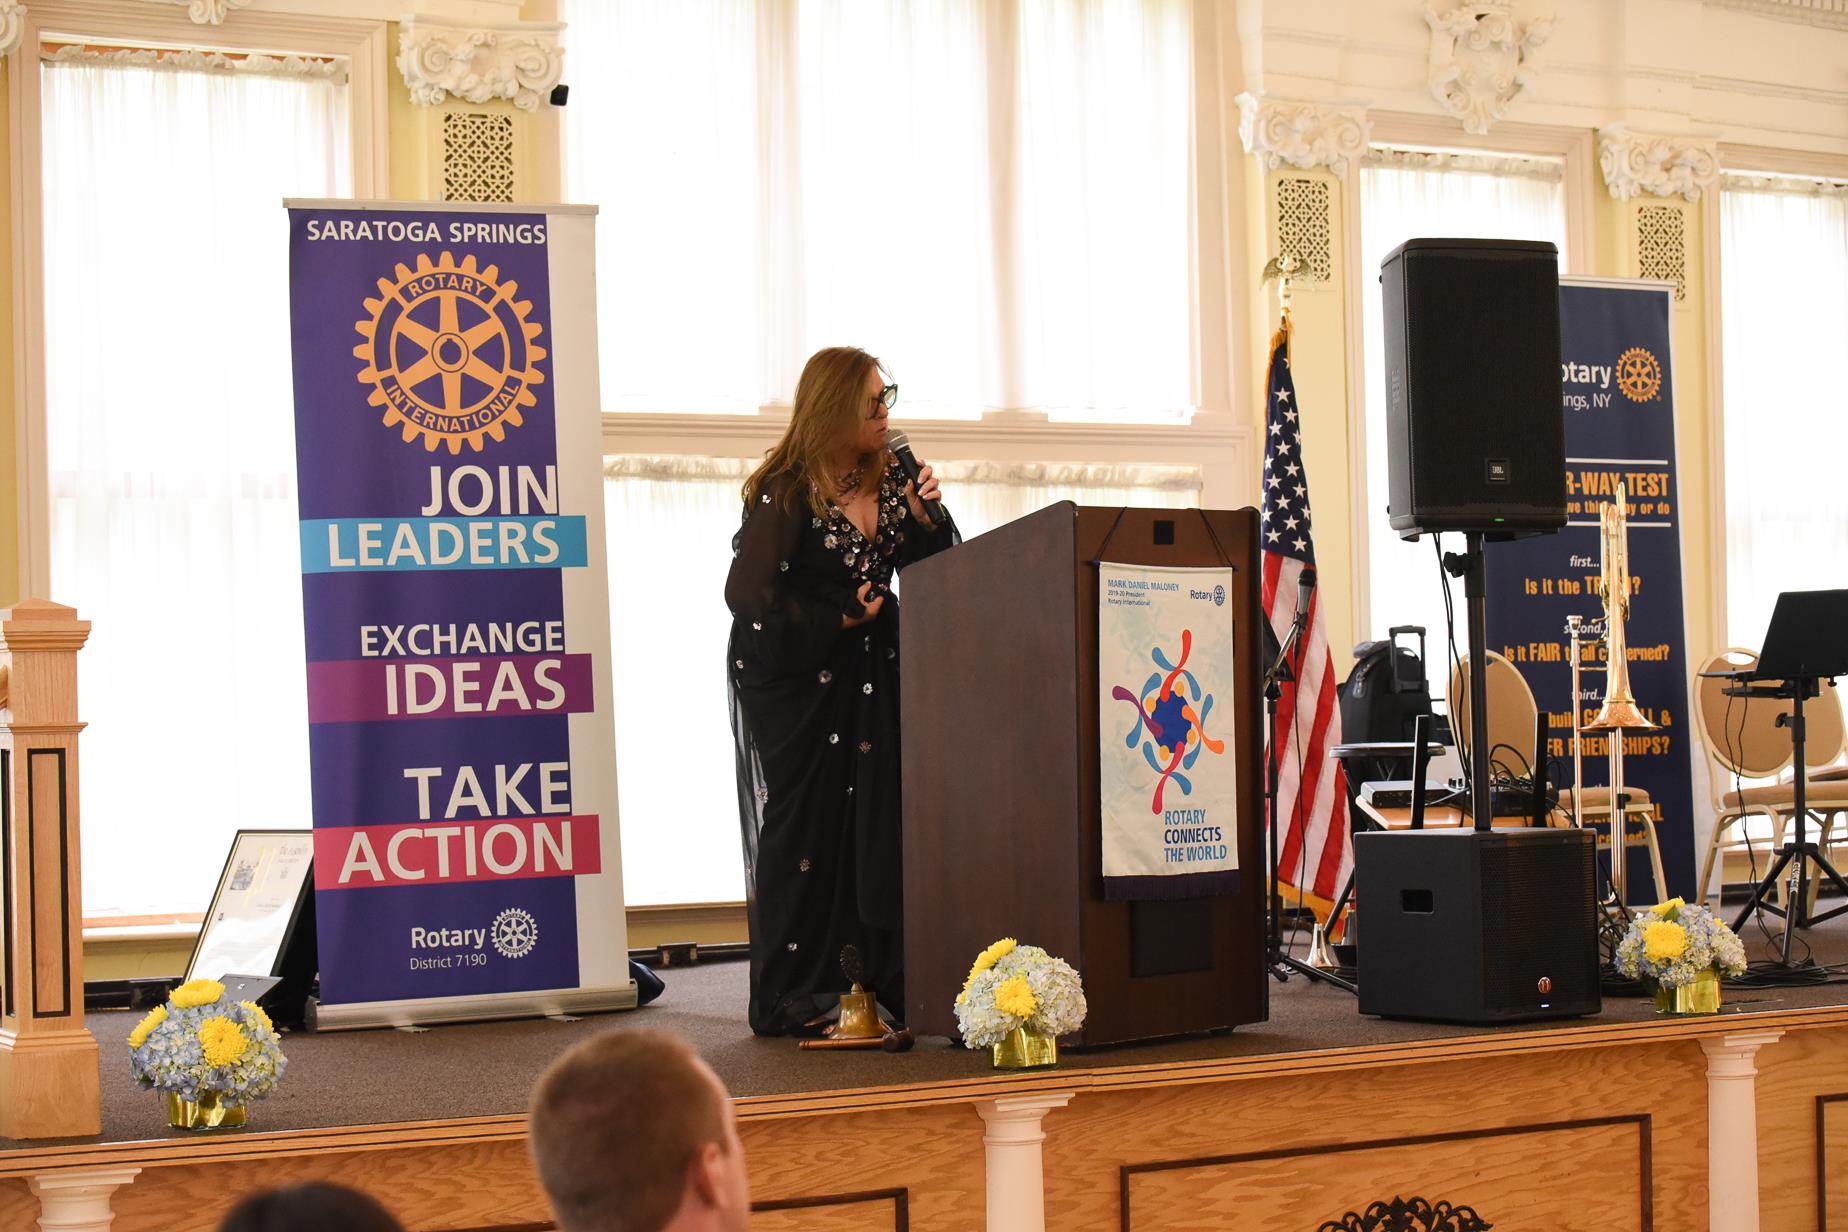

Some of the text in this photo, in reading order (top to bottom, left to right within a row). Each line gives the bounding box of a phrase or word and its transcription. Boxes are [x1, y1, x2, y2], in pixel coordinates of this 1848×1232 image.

[307, 220, 547, 245] SARATOGA SPRINGS
[407, 273, 488, 298] ROTARY
[1562, 361, 1612, 389] otary
[386, 383, 521, 434] INTERNATIONAL
[1563, 392, 1612, 411] ings, NY
[421, 464, 558, 517] JOIN
[1566, 472, 1669, 497] R-WAY TEST
[1640, 503, 1654, 515] or
[1657, 501, 1670, 515] do
[328, 520, 561, 567] LEADERS
[1570, 555, 1600, 568] first...
[1107, 579, 1180, 592] MARK DANIEL MALONEY
[1190, 589, 1213, 602] Rotary
[1525, 578, 1538, 595] Is
[1543, 577, 1553, 595] it
[1558, 577, 1581, 595] the
[360, 620, 564, 657] EXCHANGE
[1504, 645, 1515, 662] Is
[1517, 645, 1526, 662] it
[1529, 643, 1561, 662] FAIR
[1581, 645, 1595, 661] all
[1598, 644, 1670, 662] cerned?
[385, 659, 567, 716] IDEAS
[1548, 711, 1575, 728] buil
[1661, 709, 1672, 726] &
[1568, 735, 1671, 757] FRIENSHIPS?
[403, 761, 571, 820] TAKE
[1164, 808, 1207, 825] ROTARY
[1164, 826, 1222, 844] CONNECTS
[337, 821, 574, 884] ACTION
[1164, 845, 1227, 863] THE WORLD
[411, 927, 486, 949] Rotary
[410, 953, 487, 970] District 7190
